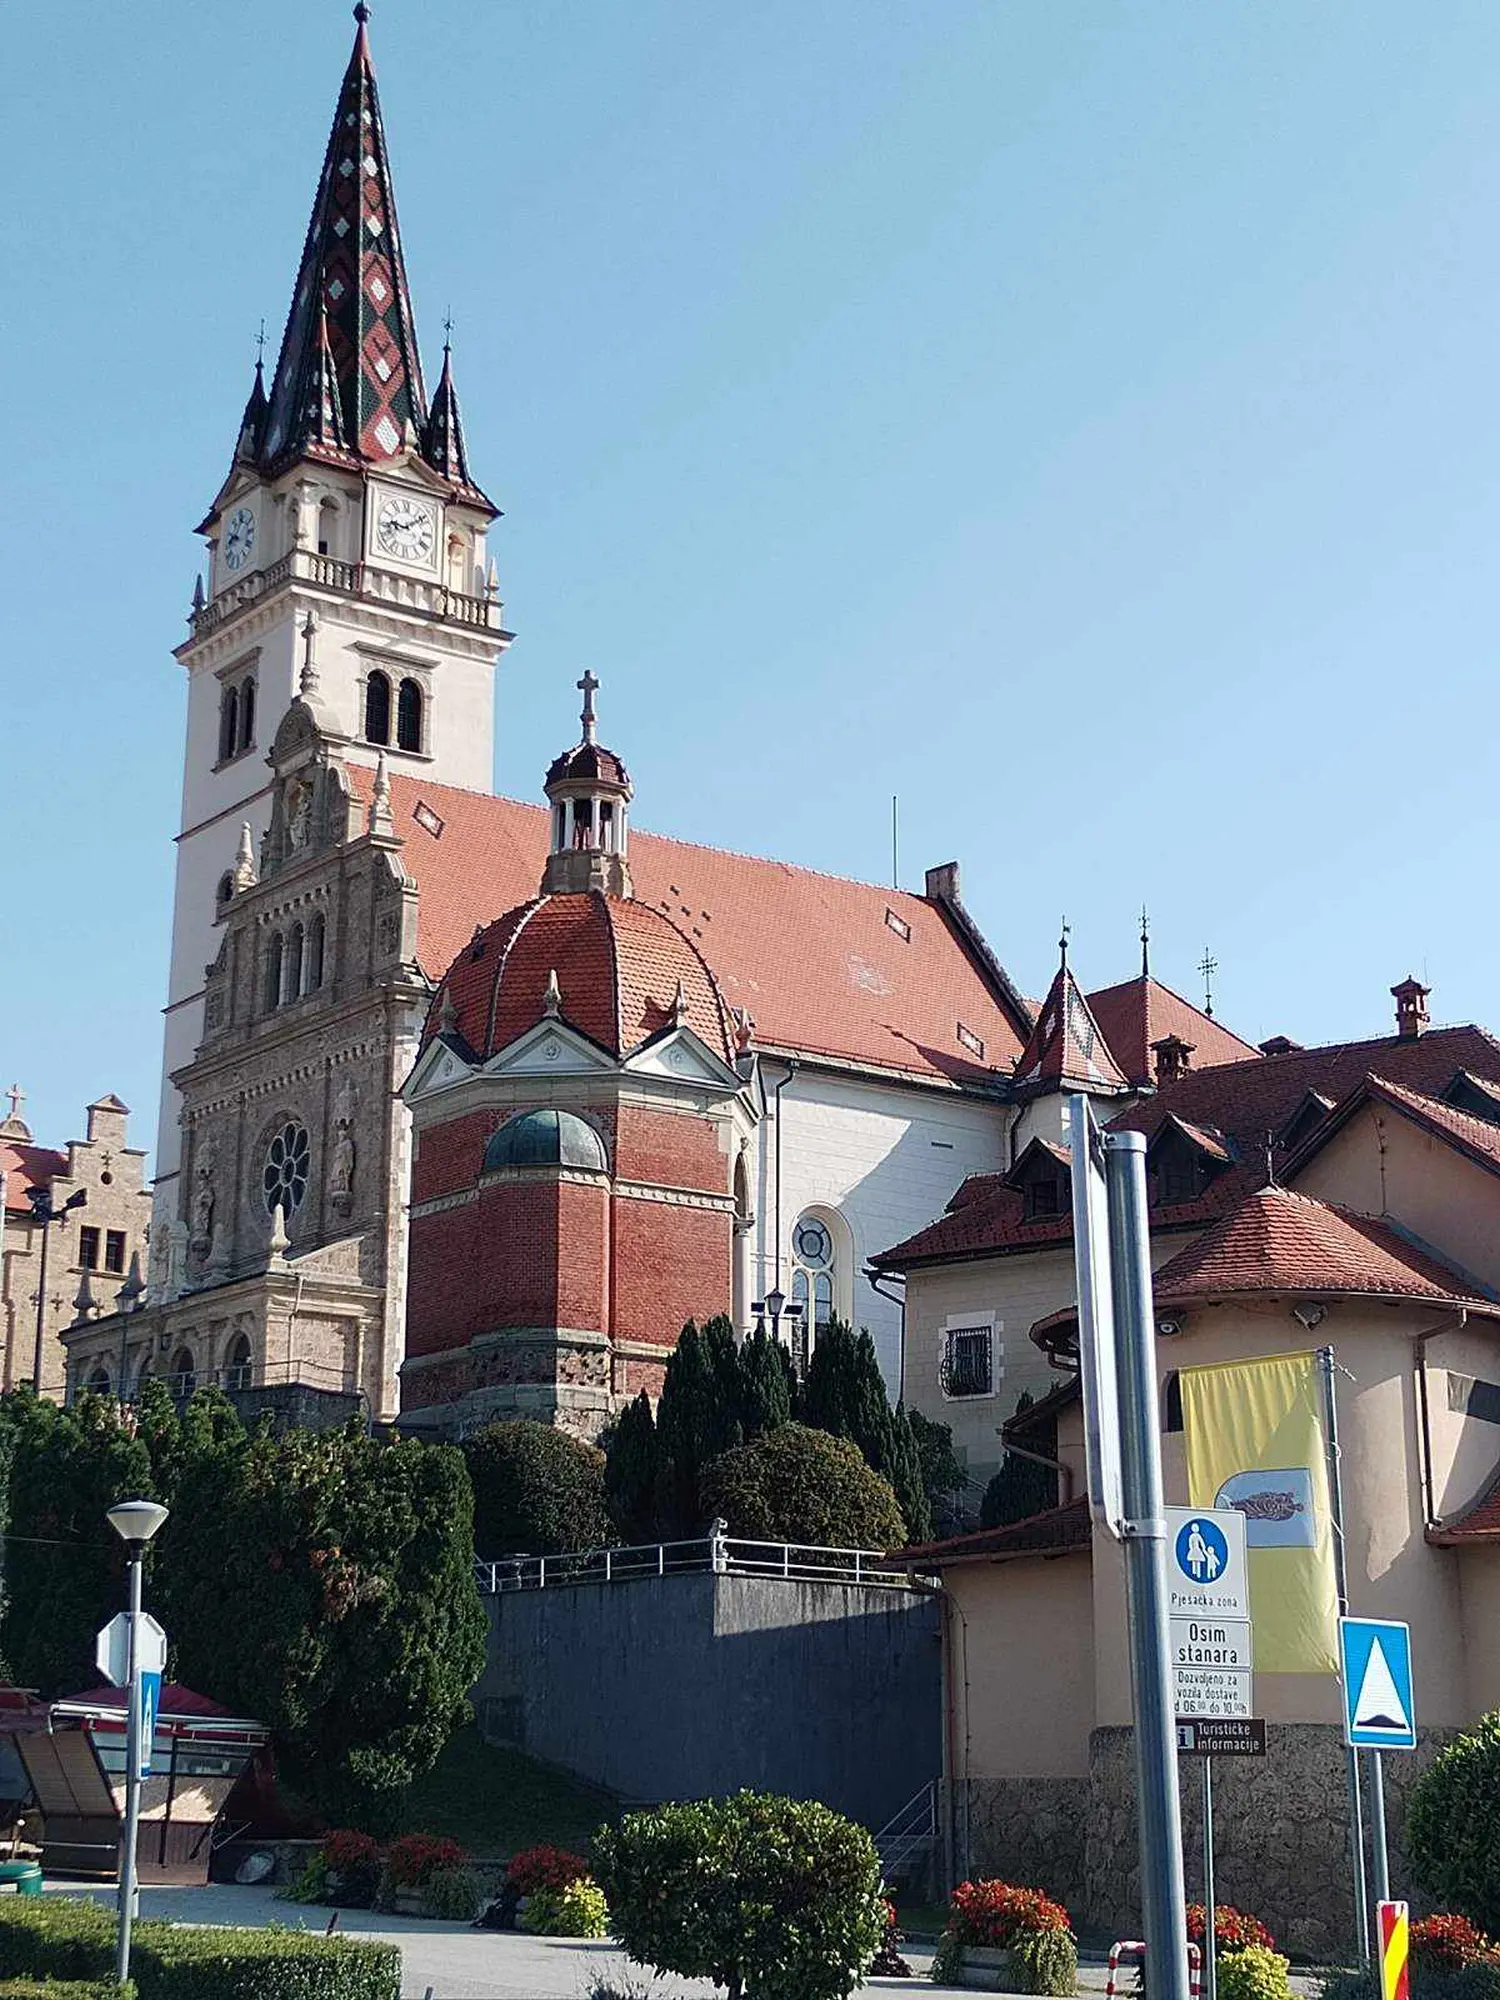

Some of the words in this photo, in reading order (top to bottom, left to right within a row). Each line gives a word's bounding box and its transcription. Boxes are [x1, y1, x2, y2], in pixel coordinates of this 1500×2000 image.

[1217, 1597, 1237, 1607] zona
[1189, 1623, 1225, 1642] Osim
[1178, 1644, 1237, 1663] stanara
[1178, 1671, 1223, 1686] Dozvoljeno
[1228, 1676, 1237, 1685] za
[1177, 1687, 1201, 1698] vozila
[1205, 1688, 1238, 1700] dostave
[1209, 1702, 1220, 1713] do
[1198, 1737, 1260, 1753] informacije
